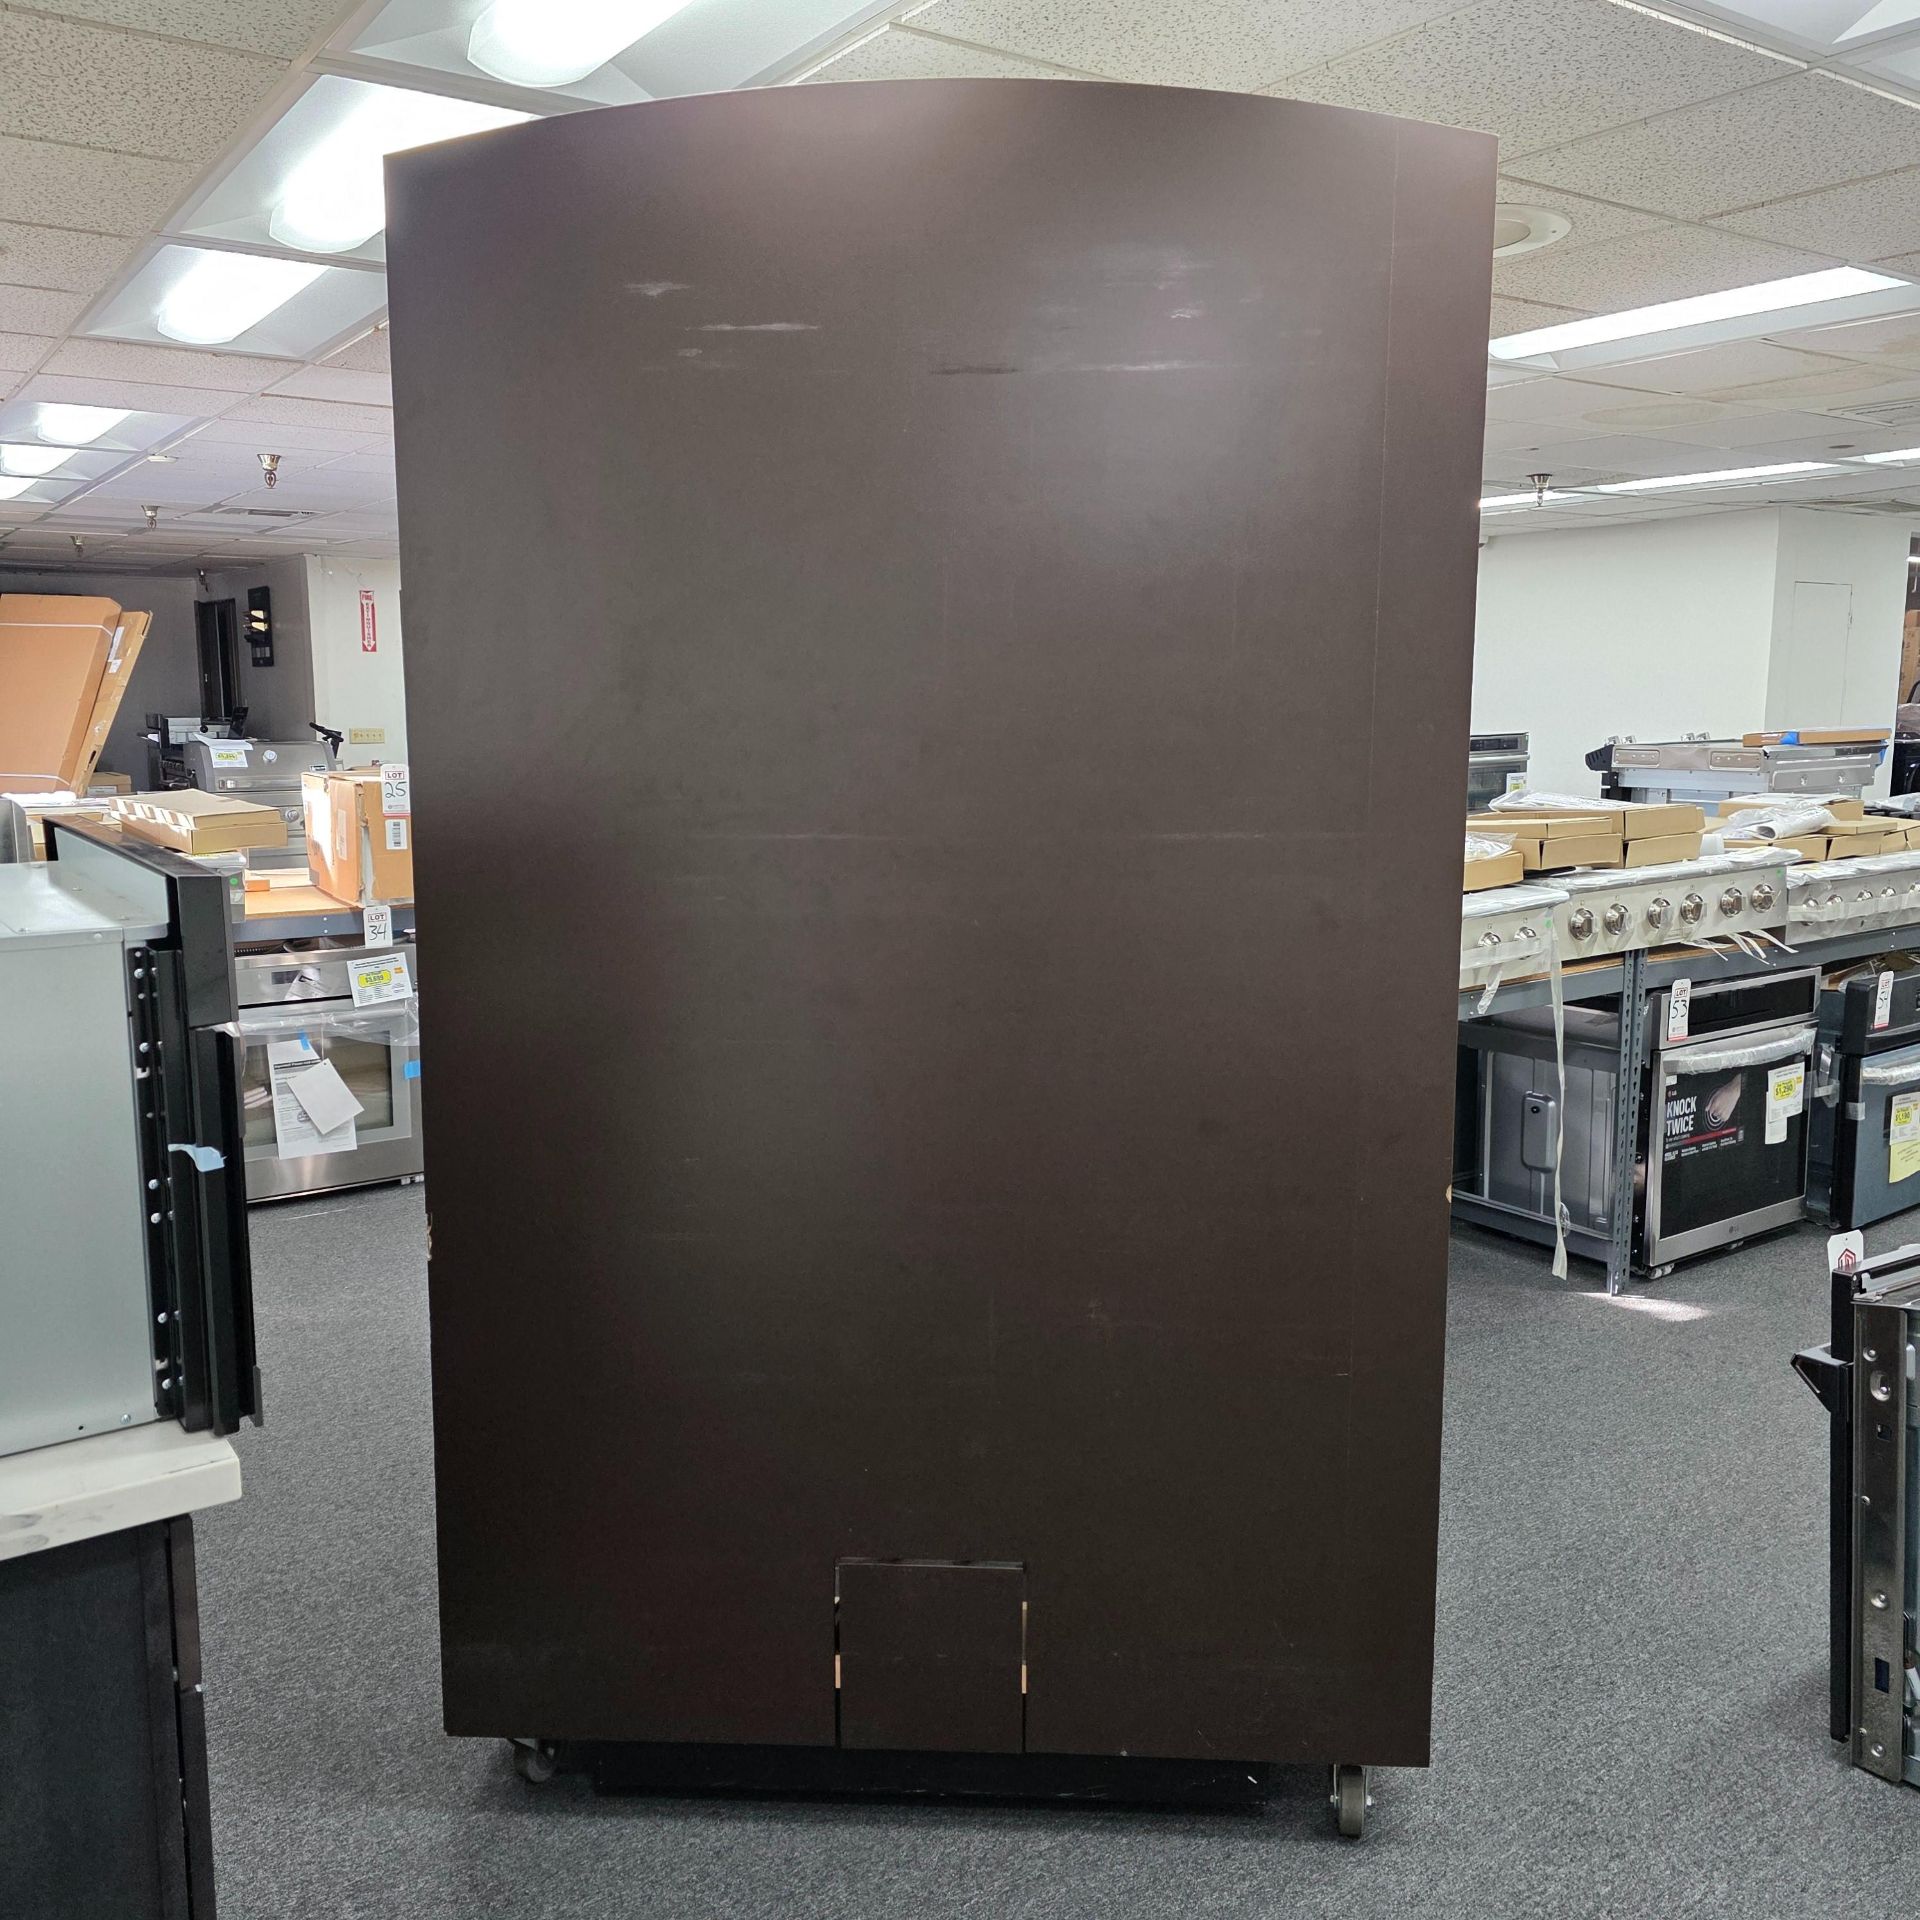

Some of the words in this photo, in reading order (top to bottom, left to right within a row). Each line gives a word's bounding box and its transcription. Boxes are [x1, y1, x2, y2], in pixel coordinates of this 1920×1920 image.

[384, 781, 408, 799] 25
[368, 923, 388, 941] 34
[1676, 989, 1687, 997] LOT
[1671, 999, 1688, 1019] 53
[1666, 1096, 1698, 1119] KNOCK
[1666, 1114, 1695, 1137] TWICE
